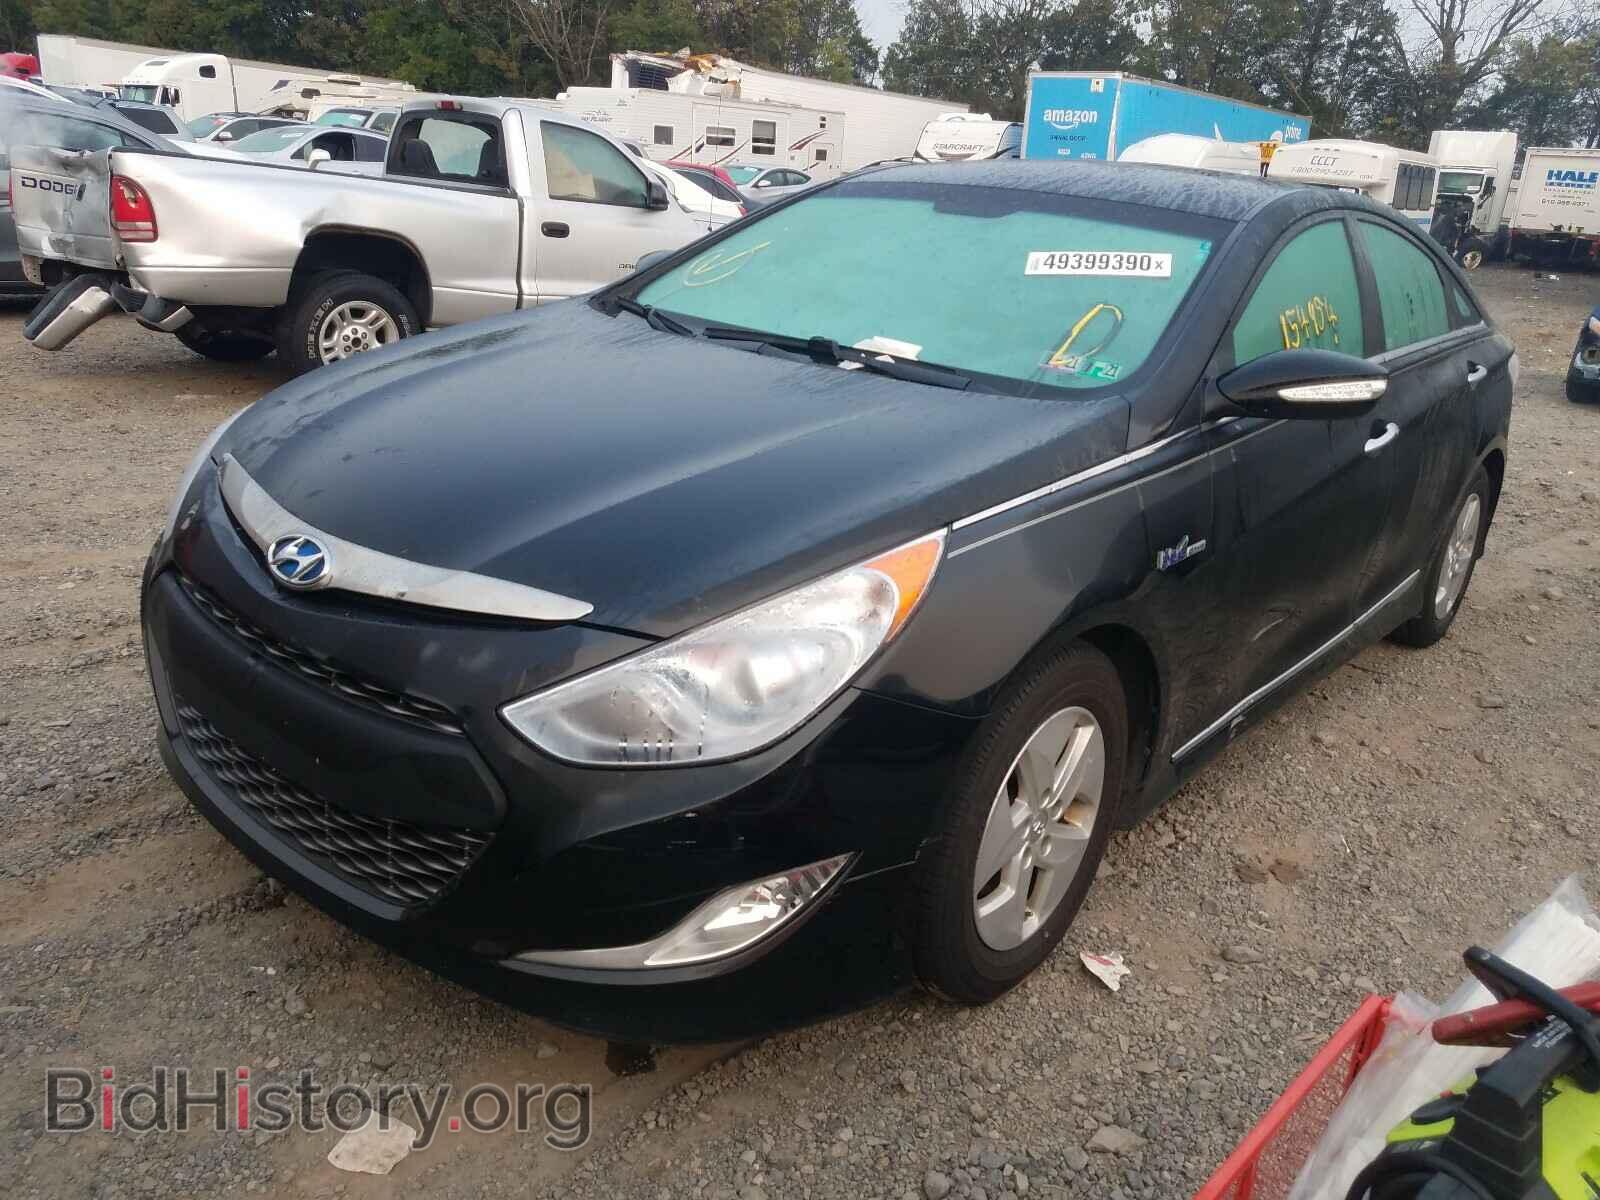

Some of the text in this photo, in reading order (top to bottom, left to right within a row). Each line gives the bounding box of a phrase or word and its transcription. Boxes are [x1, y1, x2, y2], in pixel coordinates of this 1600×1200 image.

[1043, 109, 1098, 124] amazon
[932, 143, 985, 152] STARCRAFT
[1546, 169, 1600, 184] HALE
[21, 176, 78, 195] DODG
[1043, 253, 1152, 271] 49399390
